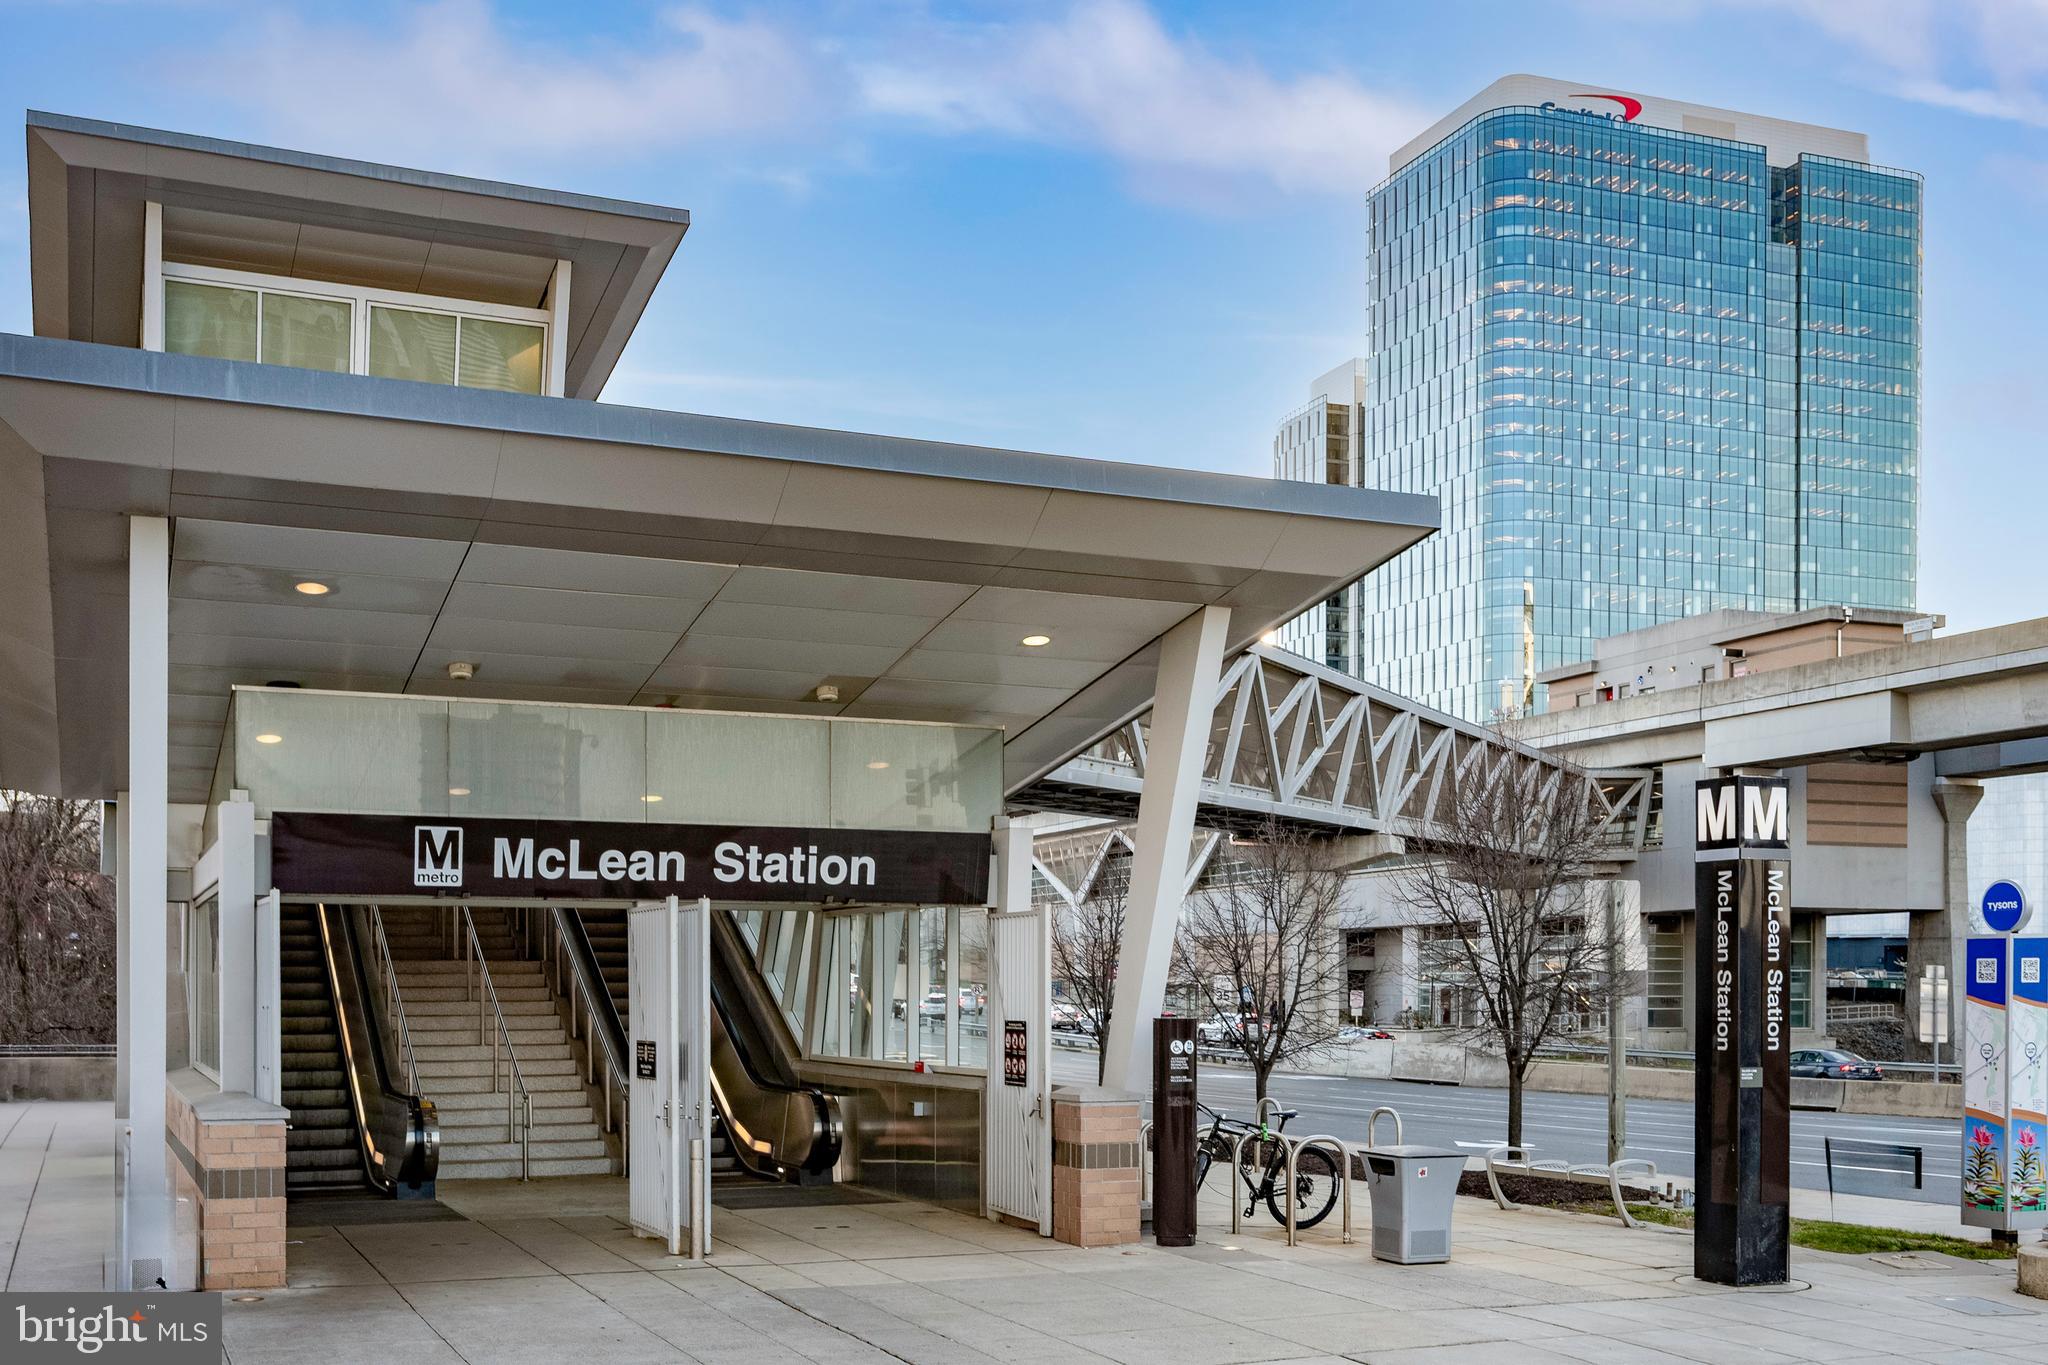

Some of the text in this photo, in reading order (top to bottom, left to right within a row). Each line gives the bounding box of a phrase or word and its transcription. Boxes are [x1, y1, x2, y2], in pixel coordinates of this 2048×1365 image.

[1698, 785, 1736, 841] M
[1744, 785, 1787, 841] M
[418, 829, 460, 869] M
[493, 837, 876, 886] McLean Station
[417, 872, 459, 883] metro
[1717, 870, 1732, 1051] McLean Station
[1767, 870, 1784, 1051] McLean Station
[1216, 990, 1230, 1001] 35
